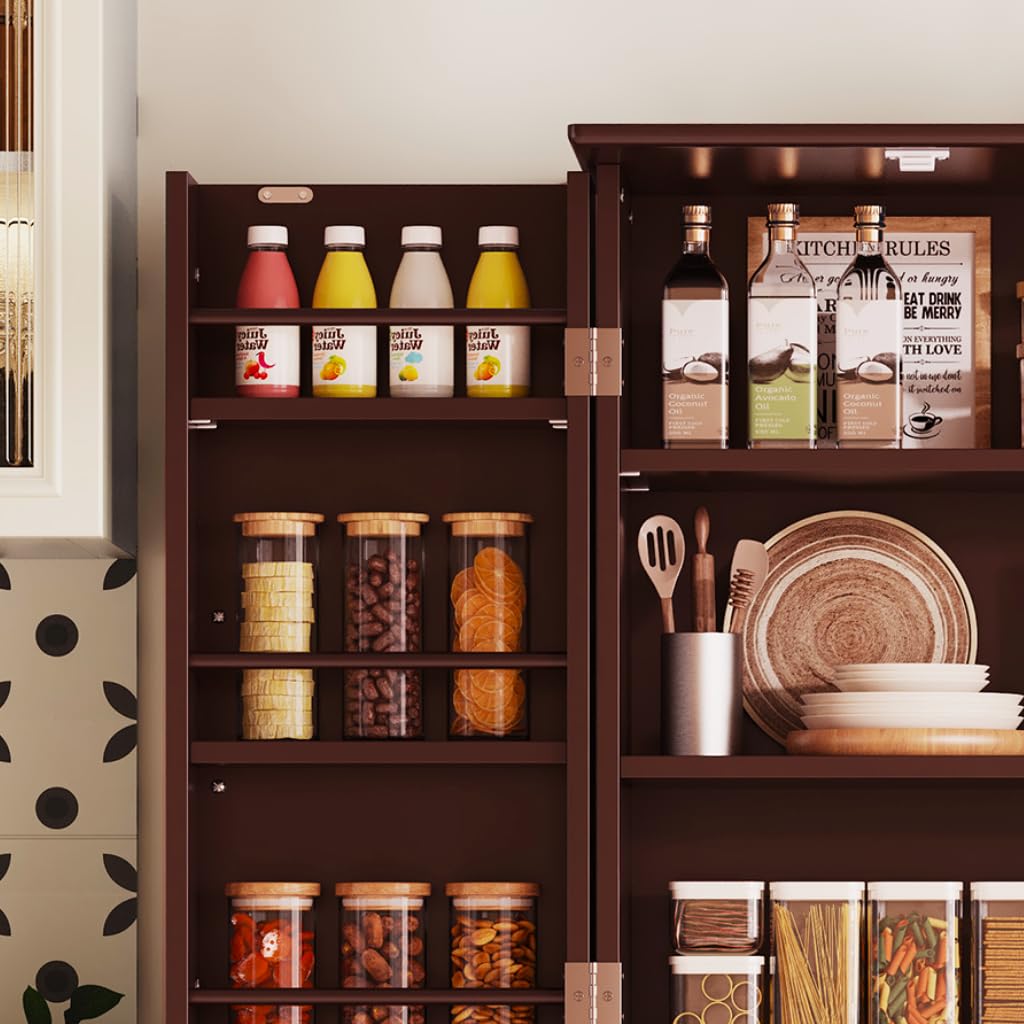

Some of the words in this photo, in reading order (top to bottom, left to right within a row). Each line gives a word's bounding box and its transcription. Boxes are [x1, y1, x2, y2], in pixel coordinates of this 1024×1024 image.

[885, 240, 950, 256] RULES
[921, 272, 959, 285] hungry
[904, 292, 925, 305] EAT
[929, 292, 962, 305] DRINK
[904, 306, 917, 319] BE
[922, 306, 962, 320] MERRY
[914, 335, 962, 343] EVERYTHING
[903, 344, 921, 355] TH
[926, 344, 962, 355] LOVE
[755, 402, 770, 410] Oil
